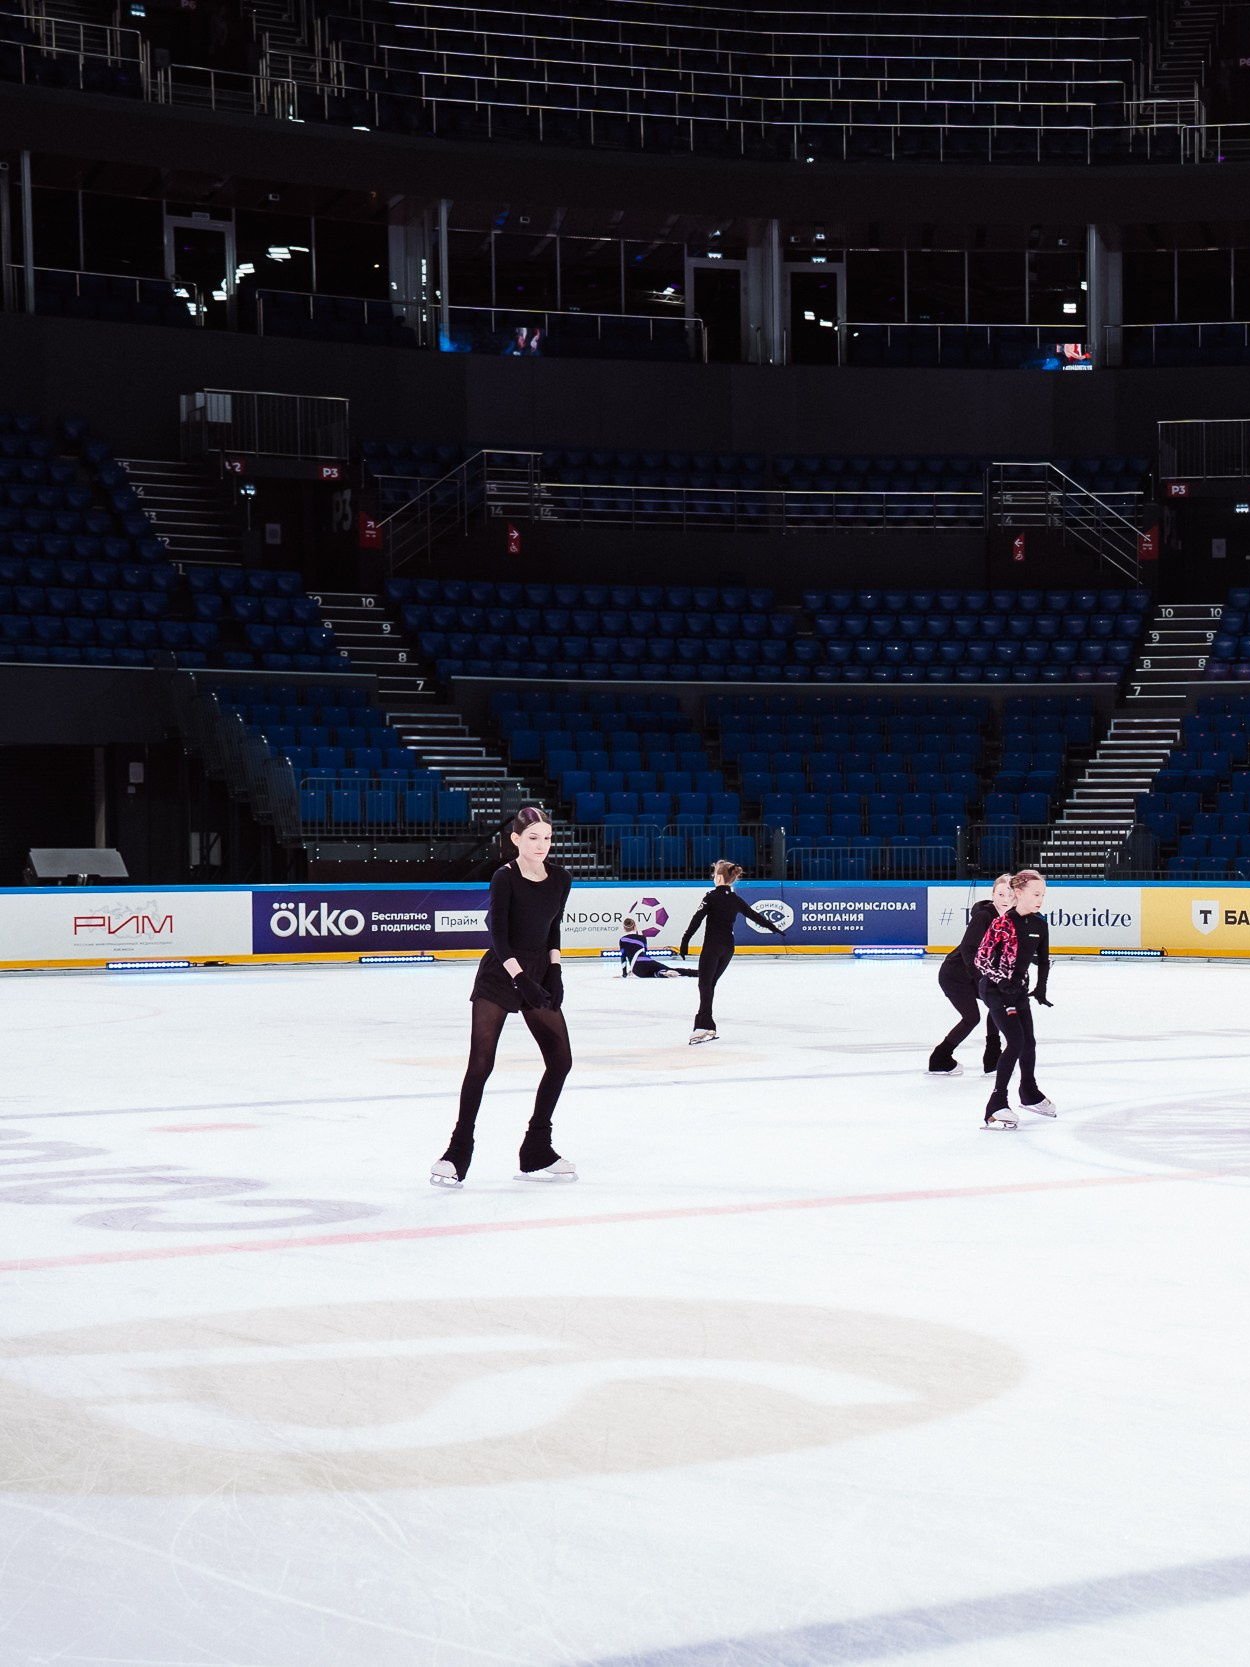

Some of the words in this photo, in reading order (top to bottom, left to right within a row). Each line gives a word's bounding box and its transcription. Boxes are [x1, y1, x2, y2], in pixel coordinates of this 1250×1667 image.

[322, 467, 339, 478] P3
[1171, 485, 1186, 495] P3
[361, 598, 375, 608] 10
[1161, 608, 1174, 618] 10
[1210, 608, 1222, 618] 10
[382, 623, 391, 634] 9
[1151, 632, 1160, 642] 9
[1206, 632, 1214, 642] 9
[398, 652, 407, 663] 8
[1143, 659, 1152, 669] 8
[1198, 658, 1206, 668] 8
[416, 680, 425, 691] 7
[1133, 686, 1142, 696] 7
[802, 902, 917, 911] РЫБОПРОМЫСЛОВАЯ
[371, 911, 428, 921] Бесплатно
[635, 912, 652, 922] TV
[802, 913, 864, 922] КОМПАНИЯ
[74, 915, 173, 935] РИМ
[441, 916, 478, 927] Прайм
[371, 924, 377, 932] в
[380, 923, 431, 932] подписке
